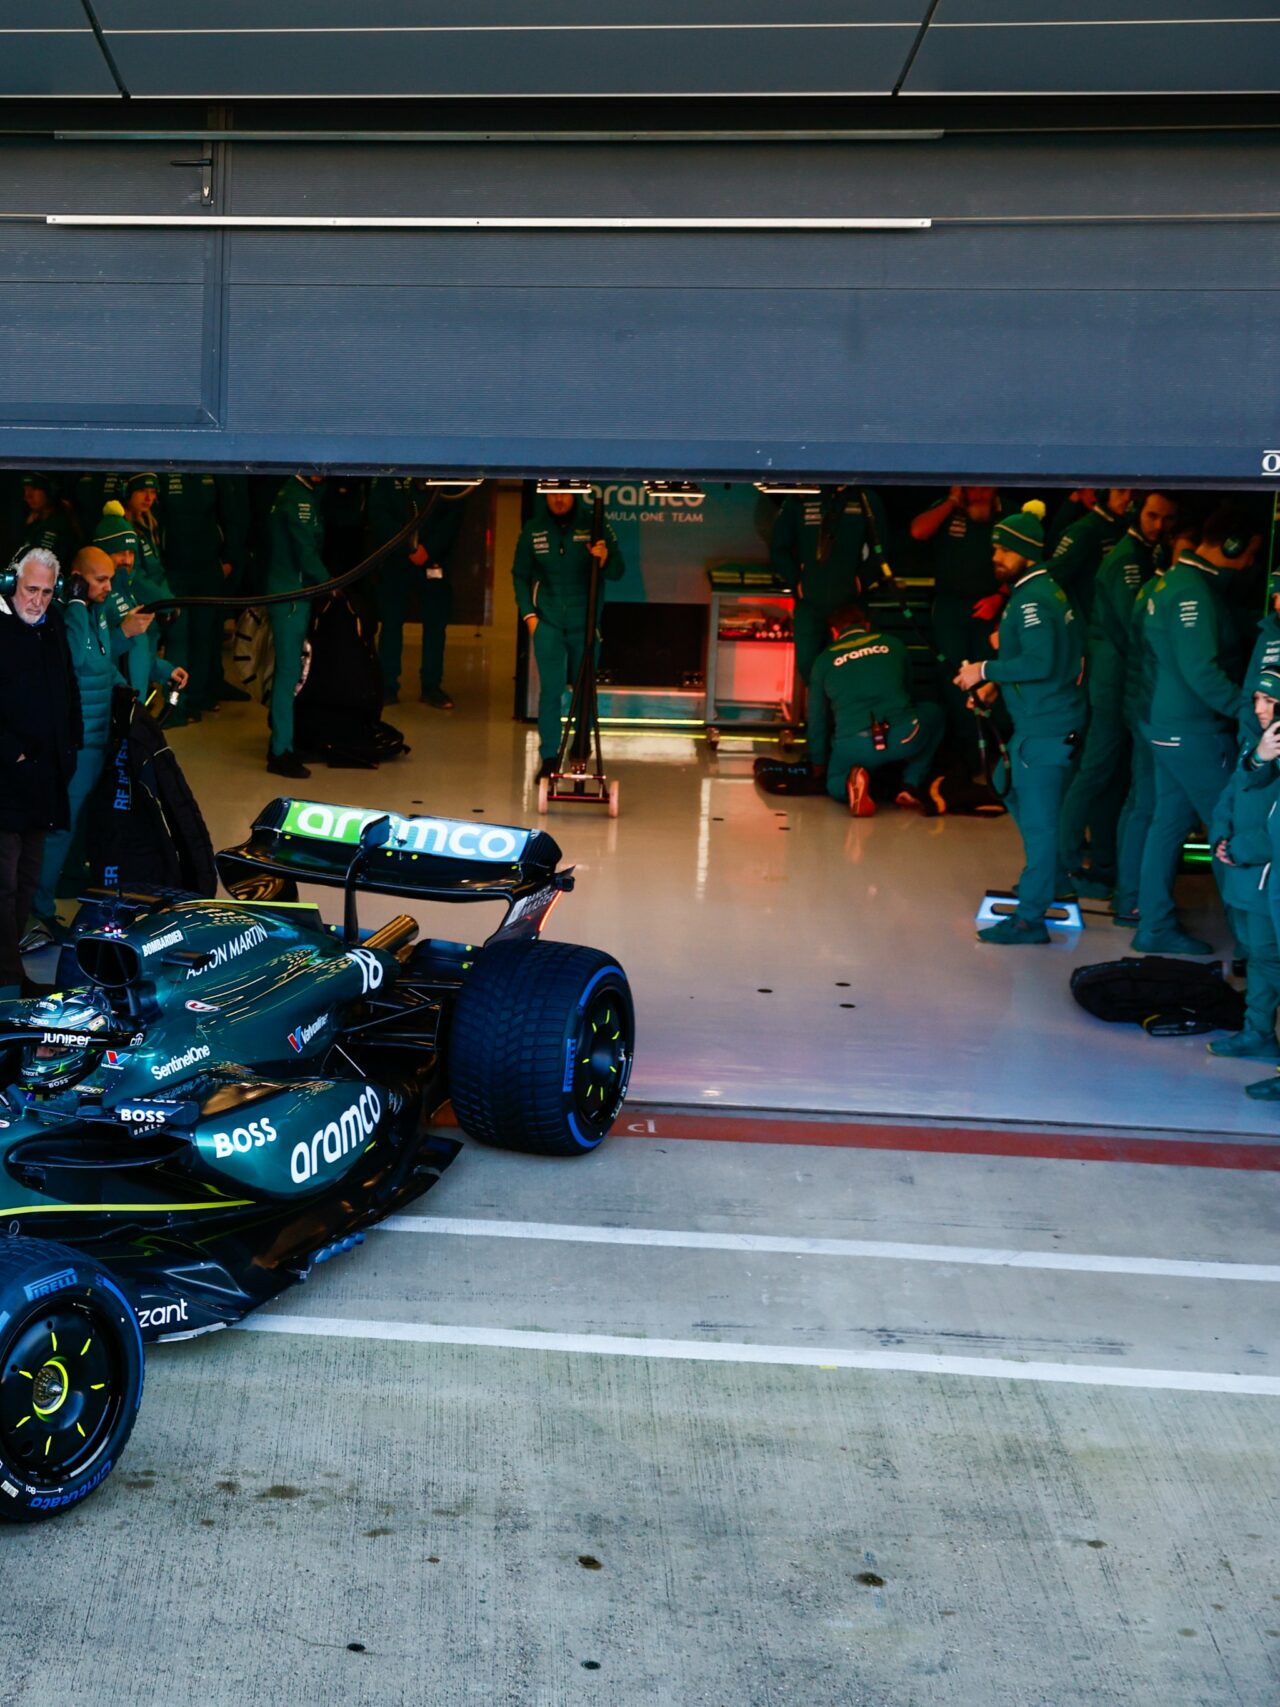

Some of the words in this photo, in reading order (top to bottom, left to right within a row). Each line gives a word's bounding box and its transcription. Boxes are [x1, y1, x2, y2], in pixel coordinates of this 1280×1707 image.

[639, 512, 665, 522] ONE
[671, 512, 704, 523] TEAM
[833, 645, 889, 667] aramco
[297, 805, 516, 859] armco
[142, 929, 184, 958] BOMBARDIER
[228, 922, 269, 960] MARTIN
[345, 948, 384, 995] 18
[151, 1044, 211, 1081] SentinelOne
[48, 1078, 69, 1089] BOSS
[120, 1108, 166, 1123] BOSS
[213, 1117, 278, 1159] BOSS
[290, 1085, 381, 1184] aramco
[24, 1267, 79, 1302] PIRELLI
[29, 1460, 113, 1511] Cinturato
